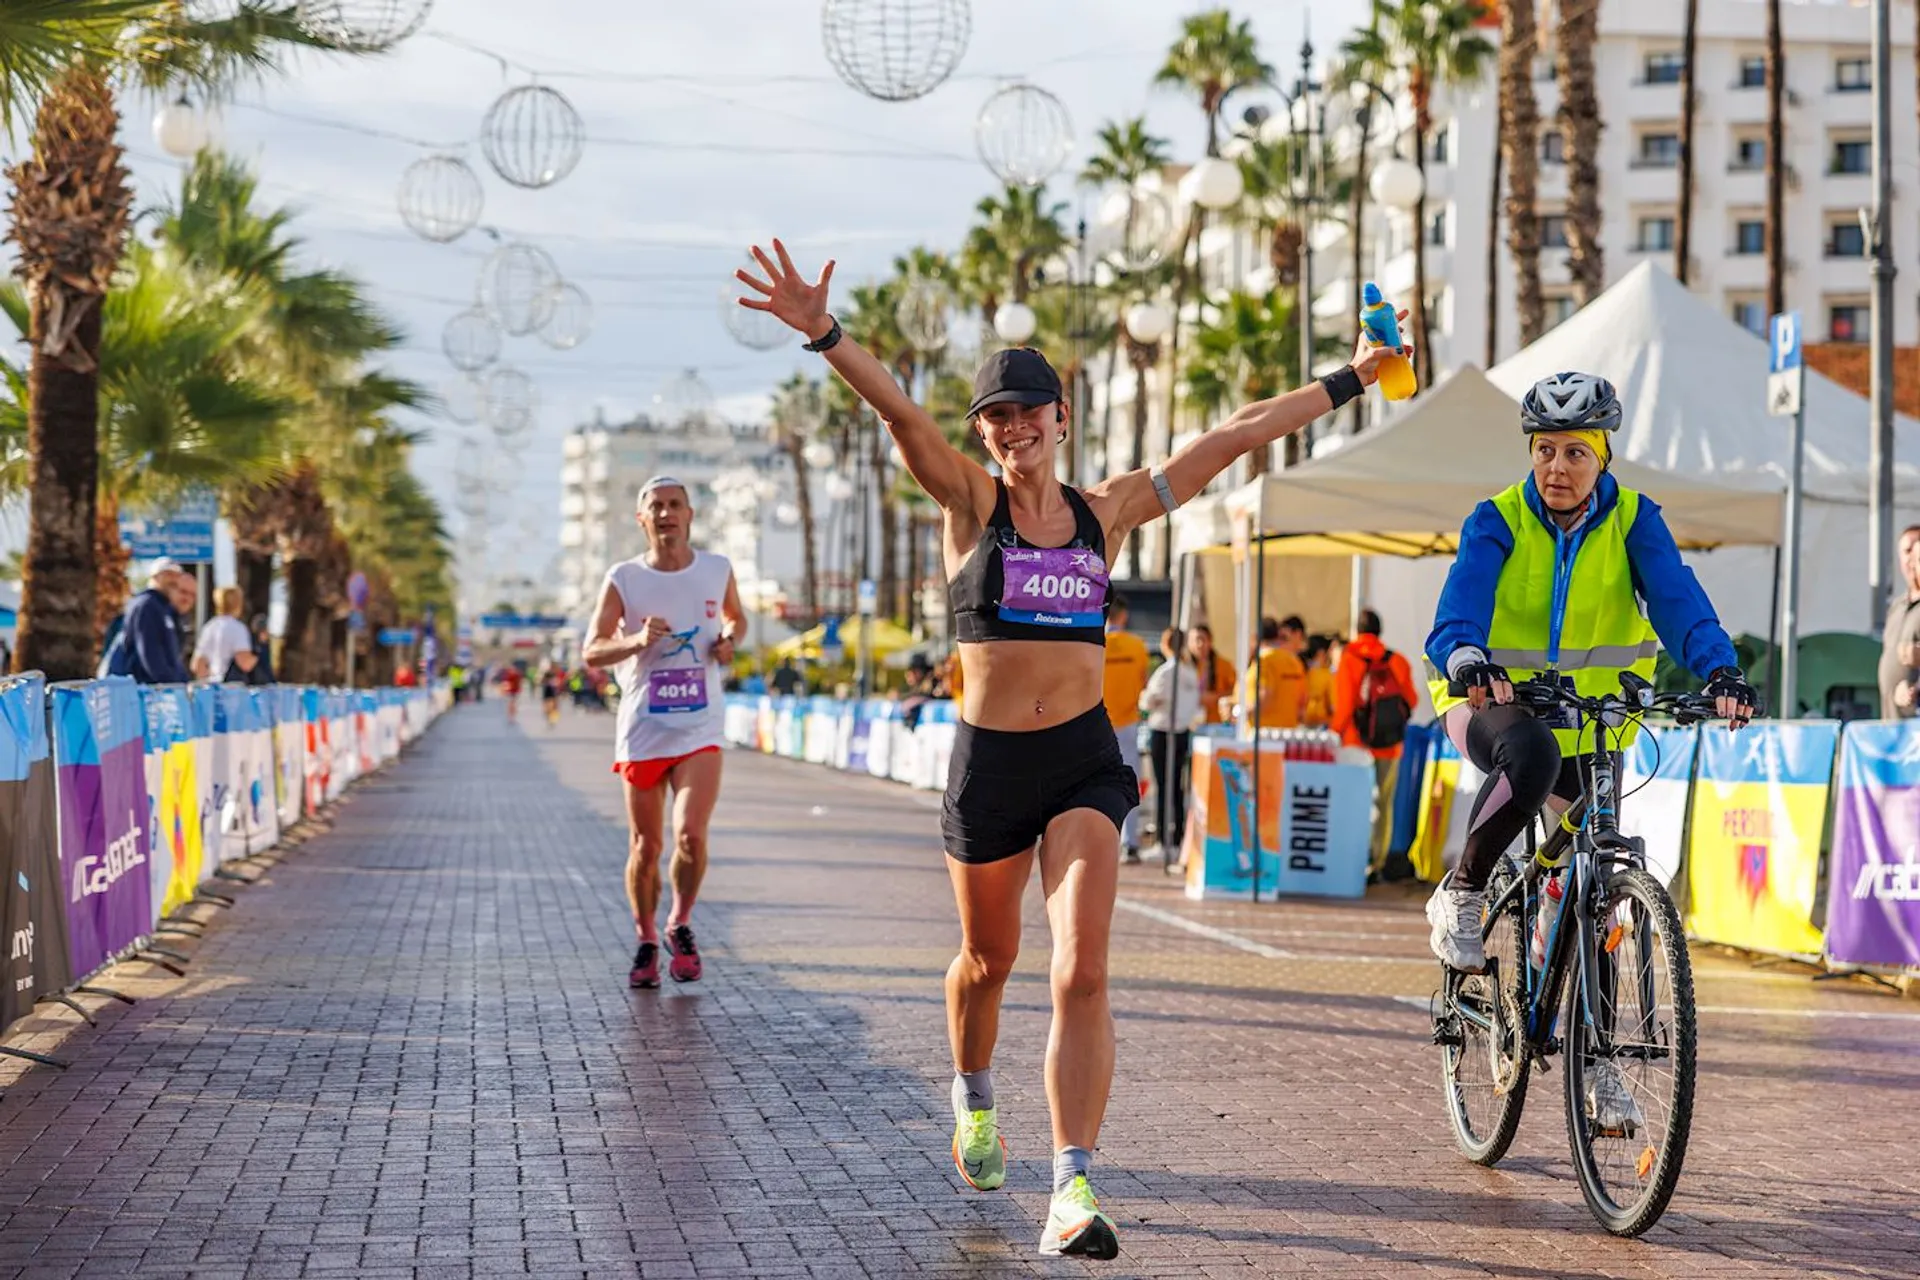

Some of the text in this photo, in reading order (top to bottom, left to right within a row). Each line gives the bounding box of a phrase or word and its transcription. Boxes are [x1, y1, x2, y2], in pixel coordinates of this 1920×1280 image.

[1776, 314, 1795, 371] P
[1022, 574, 1091, 599] 4006
[657, 683, 699, 698] 4014
[1289, 784, 1331, 873] PRIME
